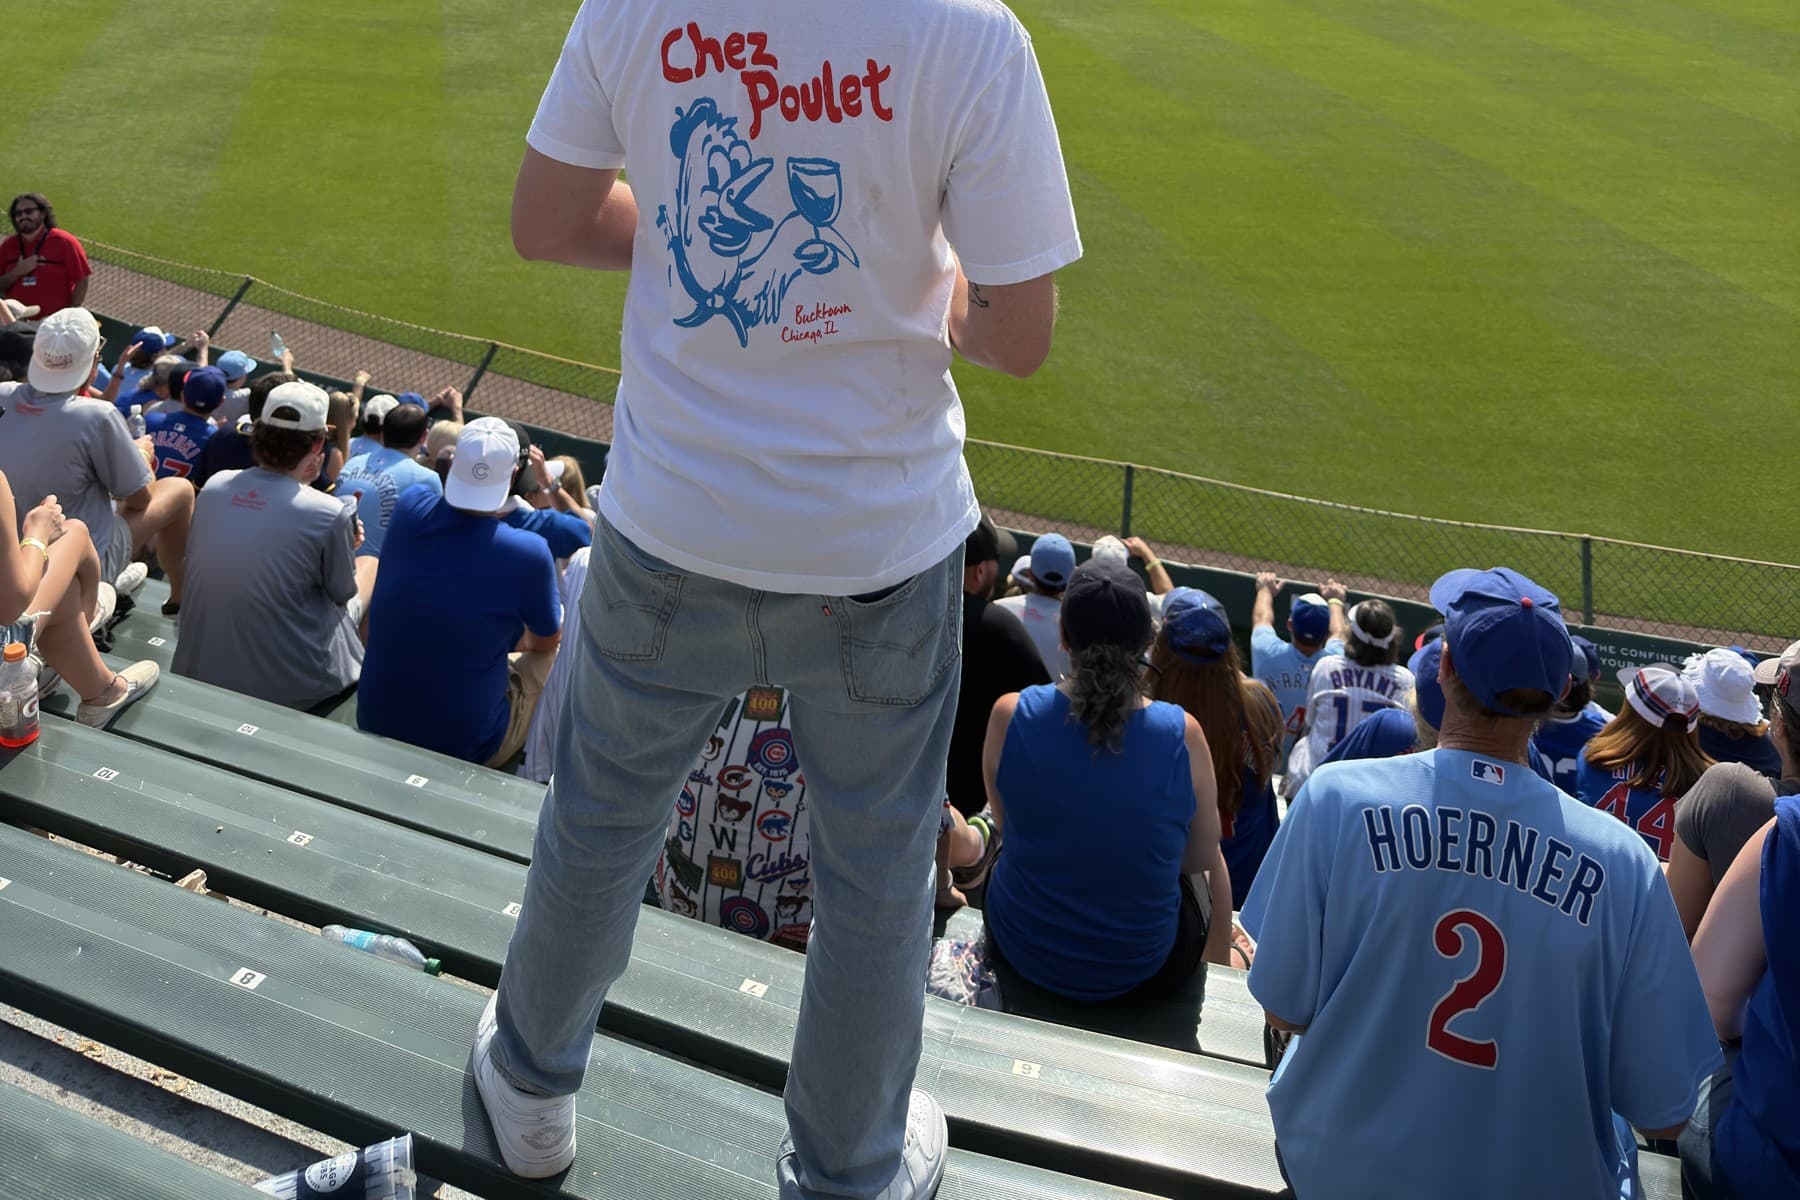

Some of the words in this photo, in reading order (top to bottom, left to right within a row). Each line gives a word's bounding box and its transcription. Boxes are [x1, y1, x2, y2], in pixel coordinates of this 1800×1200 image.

[661, 21, 778, 83] Chez
[741, 58, 893, 140] Poulet
[795, 302, 852, 325] Bucktown
[781, 326, 822, 344] Chicago,
[824, 320, 839, 334] IL
[1592, 643, 1616, 654] THE
[1620, 648, 1684, 664] CONFINES
[1600, 657, 1636, 669] YOUR
[1330, 668, 1401, 699] BRYANT
[97, 769, 114, 779] 10
[709, 823, 737, 852] W
[745, 852, 808, 882] Cubs
[1362, 804, 1605, 926] HOERNER
[239, 972, 256, 985] 8
[1425, 908, 1508, 1071] 2
